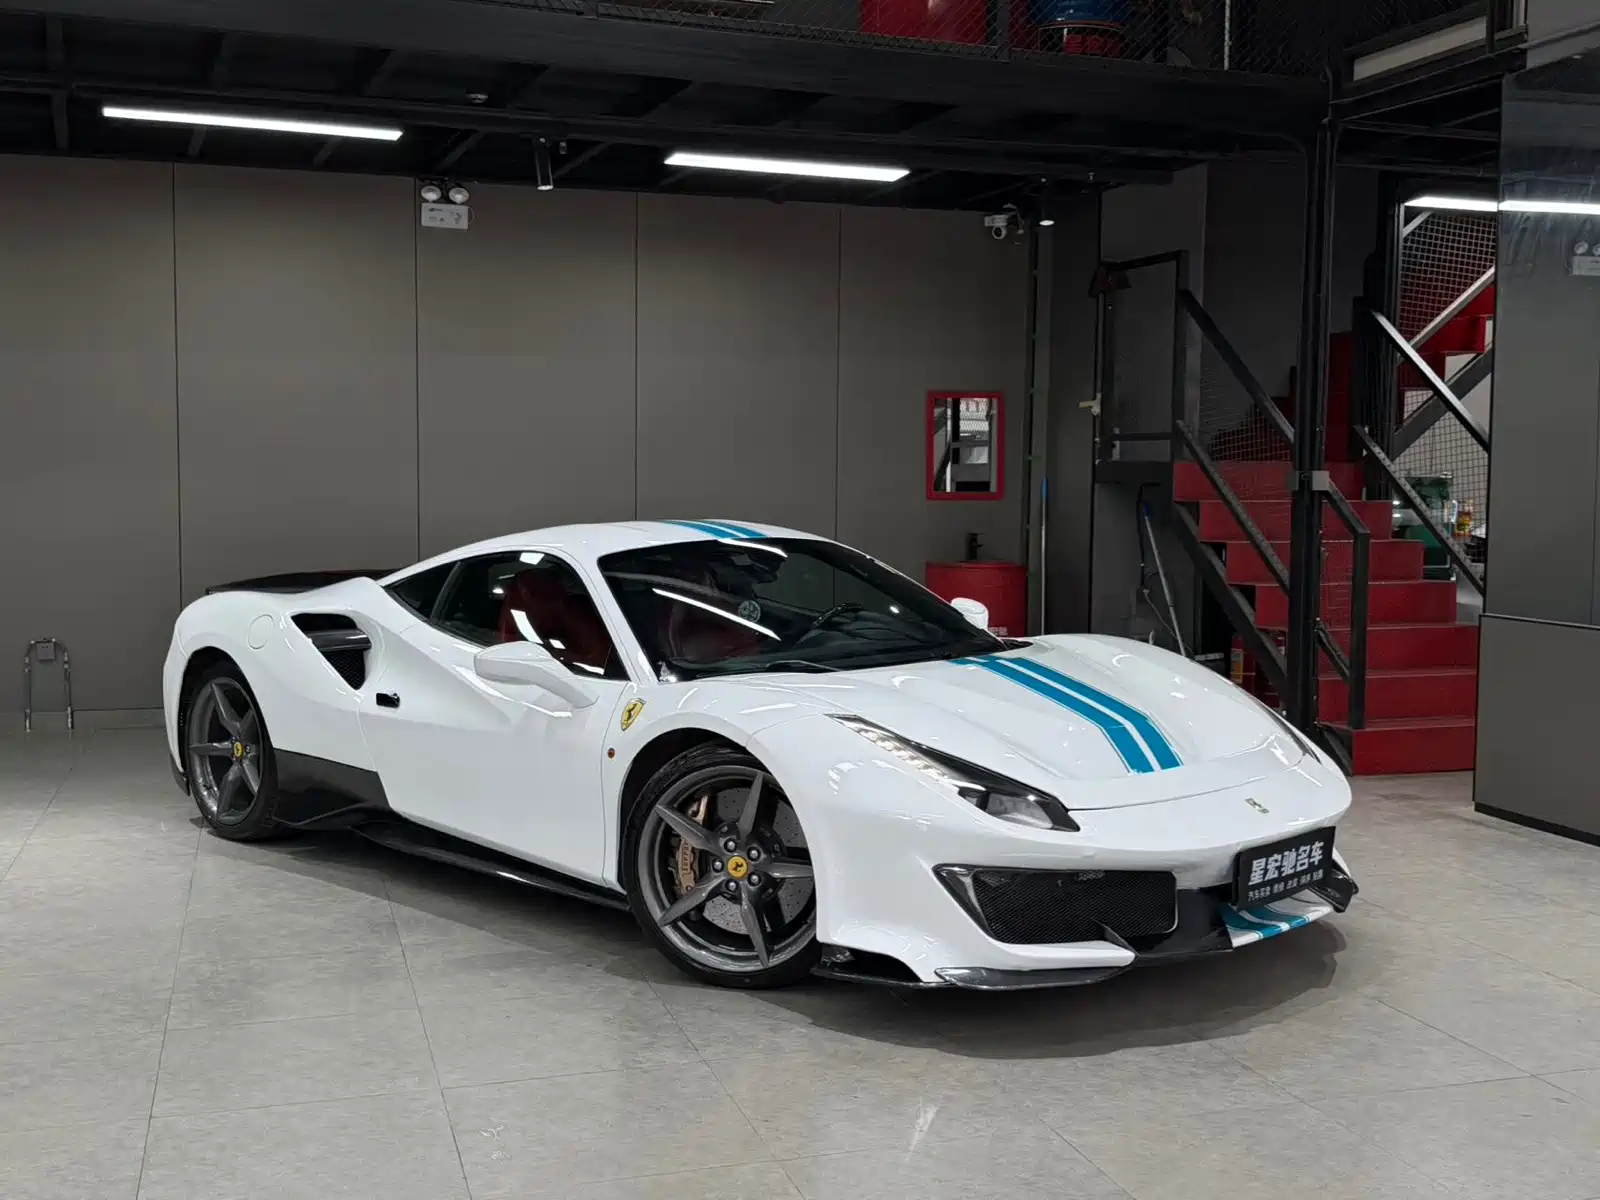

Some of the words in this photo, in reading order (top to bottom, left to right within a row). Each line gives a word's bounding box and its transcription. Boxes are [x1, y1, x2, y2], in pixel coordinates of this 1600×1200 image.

[1248, 841, 1324, 885] 星宏驰名车
